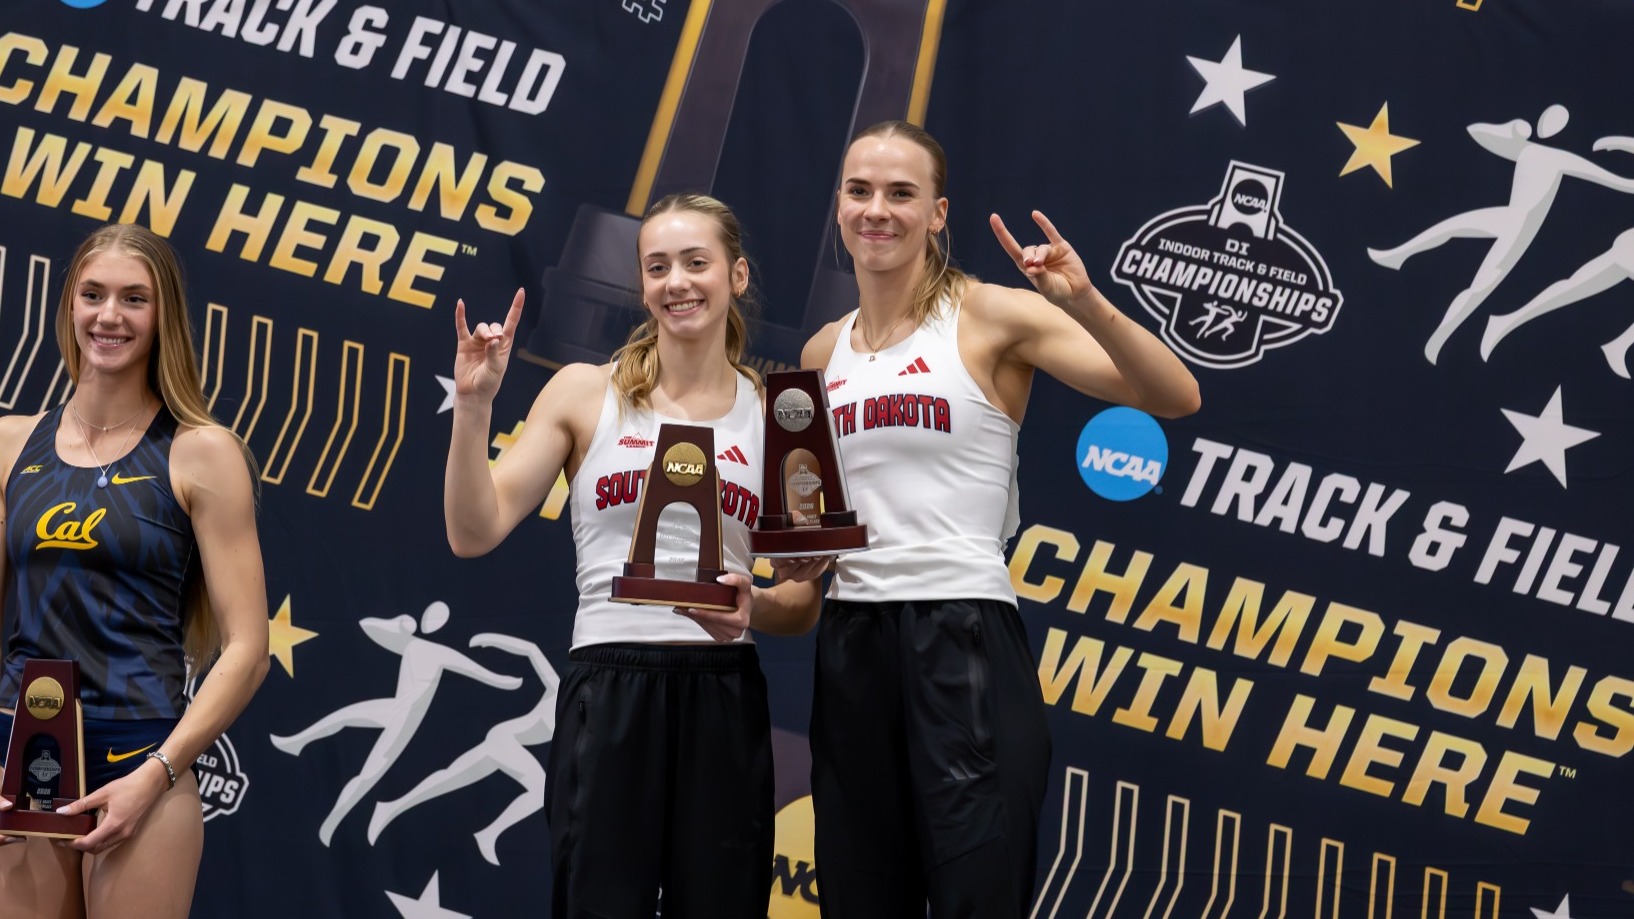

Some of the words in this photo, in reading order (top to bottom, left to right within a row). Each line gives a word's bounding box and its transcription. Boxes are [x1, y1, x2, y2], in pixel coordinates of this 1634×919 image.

[135, 0, 337, 58] ACK
[334, 5, 390, 70] &
[390, 16, 566, 115] FIELD
[0, 32, 546, 236] CHAMPIONS
[1, 126, 196, 238] WIN
[205, 183, 458, 310] HERE
[1234, 193, 1269, 213] NCAA
[1158, 238, 1210, 262] INDOOR
[1212, 251, 1255, 273] TRACK
[1257, 264, 1266, 276] &
[1269, 266, 1308, 286] FIELD
[1225, 238, 1250, 256] DI
[1121, 249, 1333, 323] CHAMPIONSHIPS
[863, 393, 952, 434] DAKOTA
[618, 439, 655, 448] SUMMIT
[22, 464, 43, 474] ACC
[596, 469, 647, 511] SOU
[665, 461, 705, 476] NCAA
[36, 502, 106, 550] Cal
[1082, 444, 1162, 486] NCAA
[1180, 437, 1411, 557] TRACK
[1409, 501, 1470, 572] &
[1007, 523, 1634, 758] CHAMPIONS
[1038, 626, 1254, 752] WIN
[1266, 694, 1556, 836] HERE
[197, 754, 218, 768] ELD
[773, 854, 820, 906] NC
